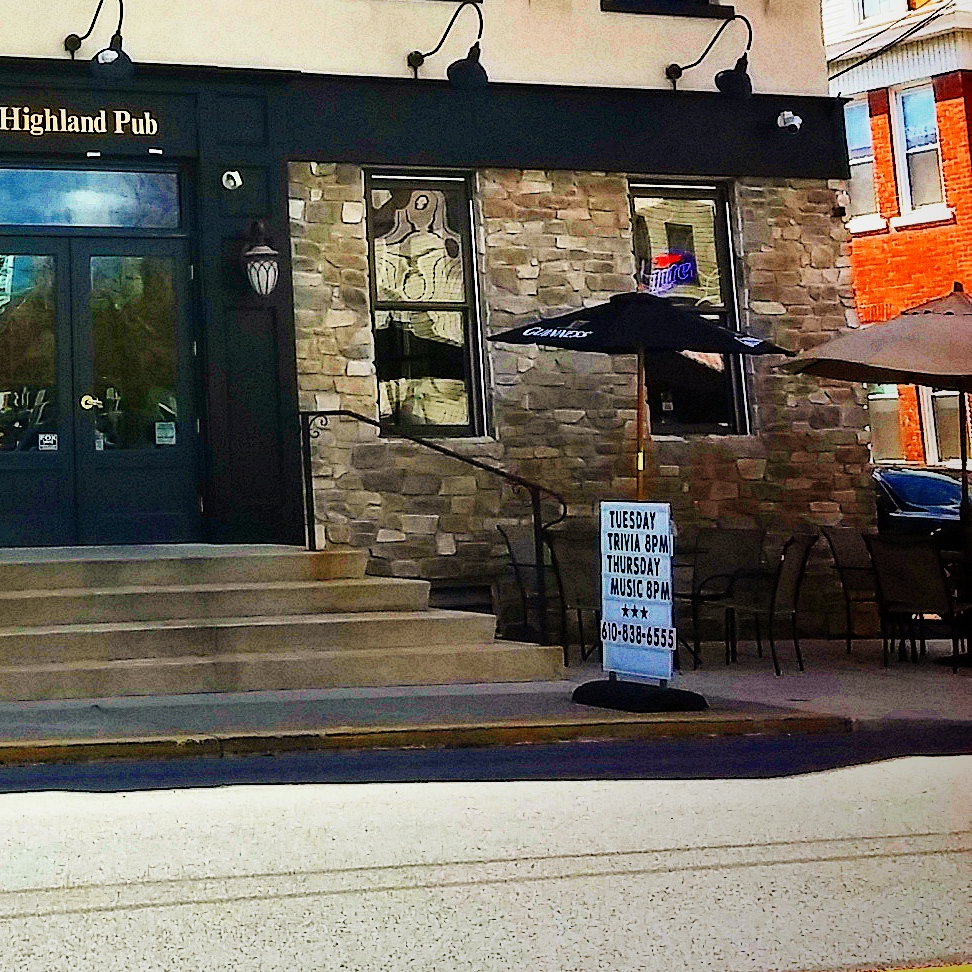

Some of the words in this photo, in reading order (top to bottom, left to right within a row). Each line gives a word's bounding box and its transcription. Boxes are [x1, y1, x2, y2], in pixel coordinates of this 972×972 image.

[112, 110, 159, 136] Pub
[609, 510, 656, 530] TUESDAY
[607, 532, 641, 553] TRIVIA
[645, 534, 669, 554] 8PM
[607, 554, 661, 577] THURSDAY
[610, 578, 643, 599] MUSIC
[646, 580, 671, 601] 8PM
[601, 621, 675, 649] 610-838-6555
